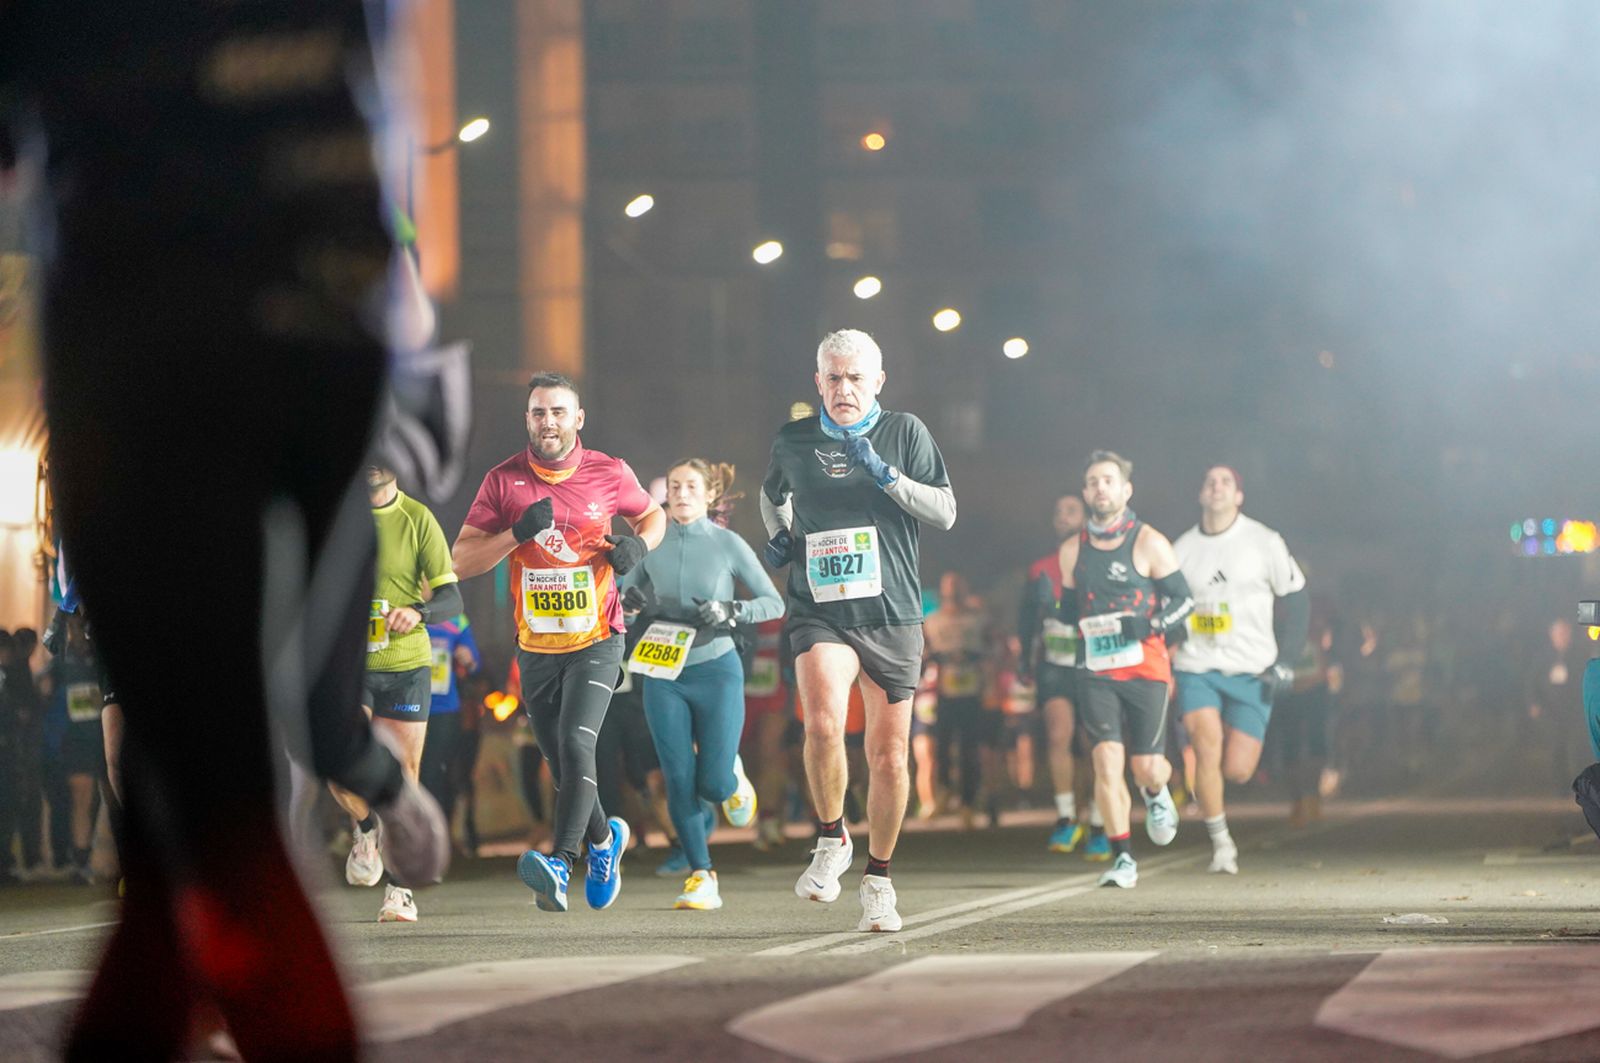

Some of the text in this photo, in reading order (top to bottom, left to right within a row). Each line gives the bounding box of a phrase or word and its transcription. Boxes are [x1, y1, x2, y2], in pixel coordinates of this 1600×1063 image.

[545, 534, 563, 553] 43
[838, 536, 848, 545] DE
[818, 553, 863, 578] 9627
[529, 583, 543, 591] SAN
[536, 575, 567, 583] NOCHE DE
[531, 590, 587, 611] 13380
[638, 642, 681, 663] 12584
